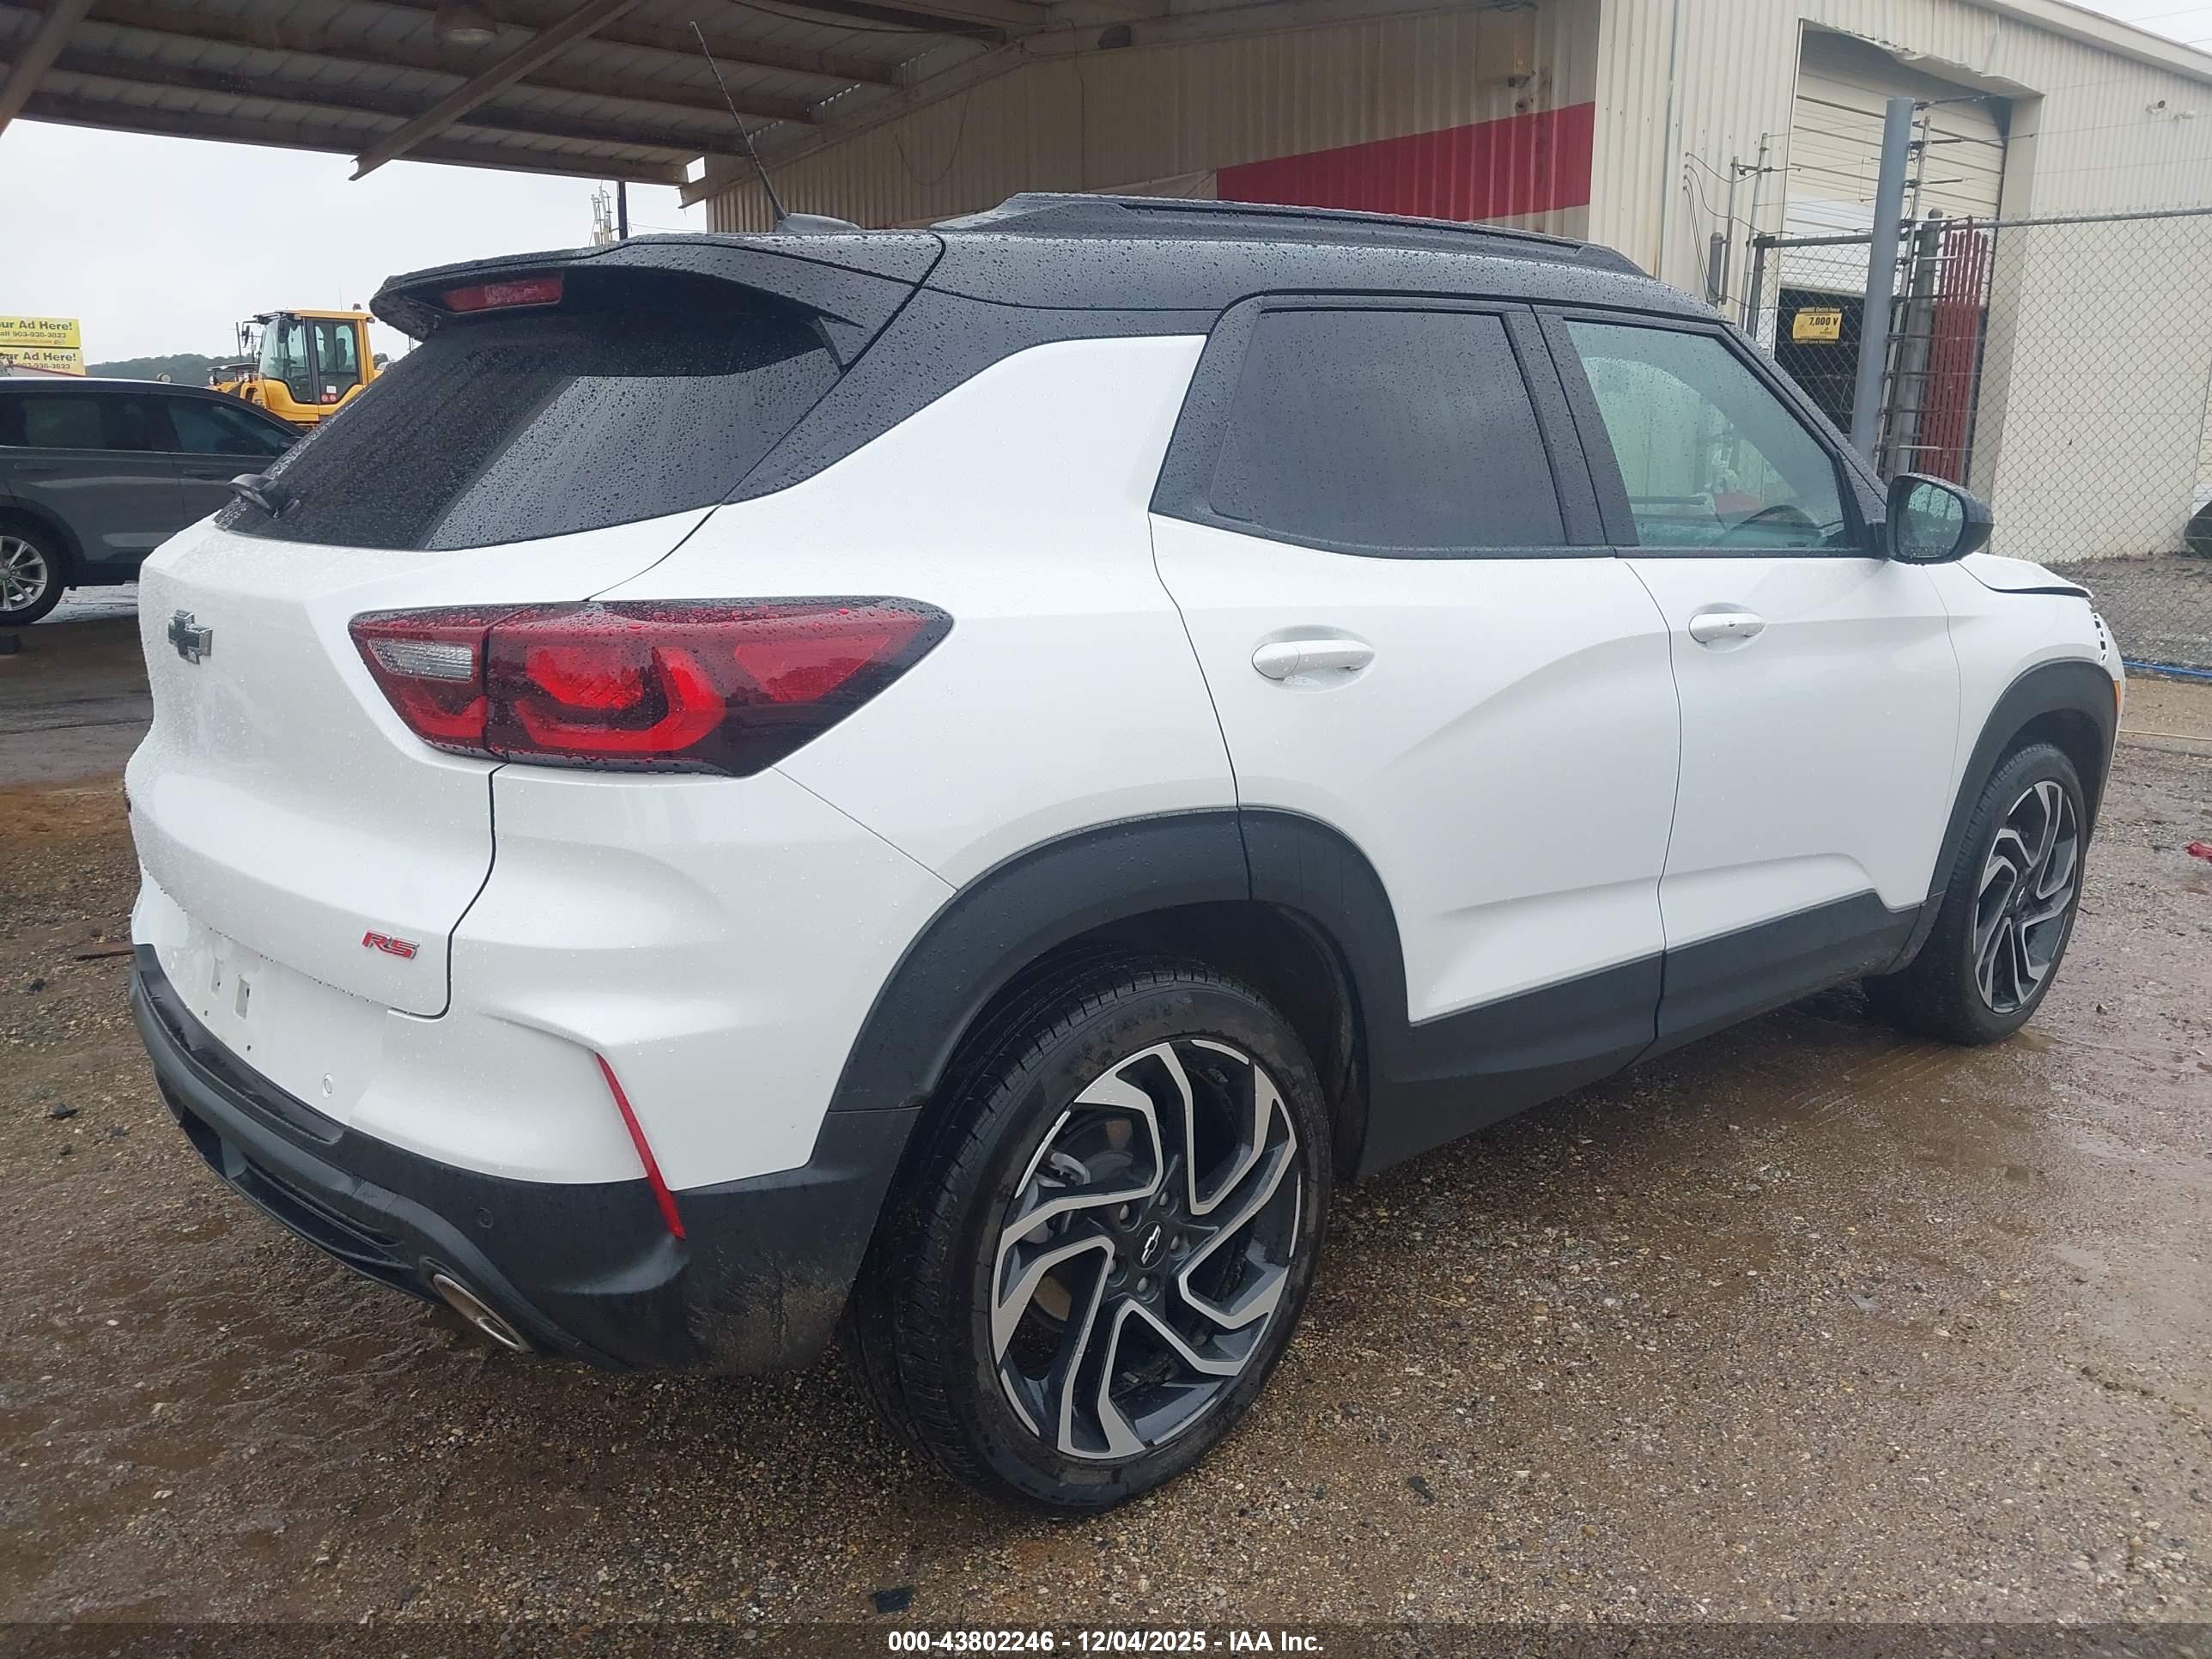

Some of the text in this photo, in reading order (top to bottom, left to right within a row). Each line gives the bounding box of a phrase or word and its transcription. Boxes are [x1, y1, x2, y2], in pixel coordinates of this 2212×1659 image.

[19, 320, 34, 329] Ad
[40, 321, 72, 331] Here!
[1809, 317, 1839, 327] 7,000 V
[23, 351, 39, 361] Ad
[43, 352, 76, 362] Here!
[361, 929, 420, 960] RS
